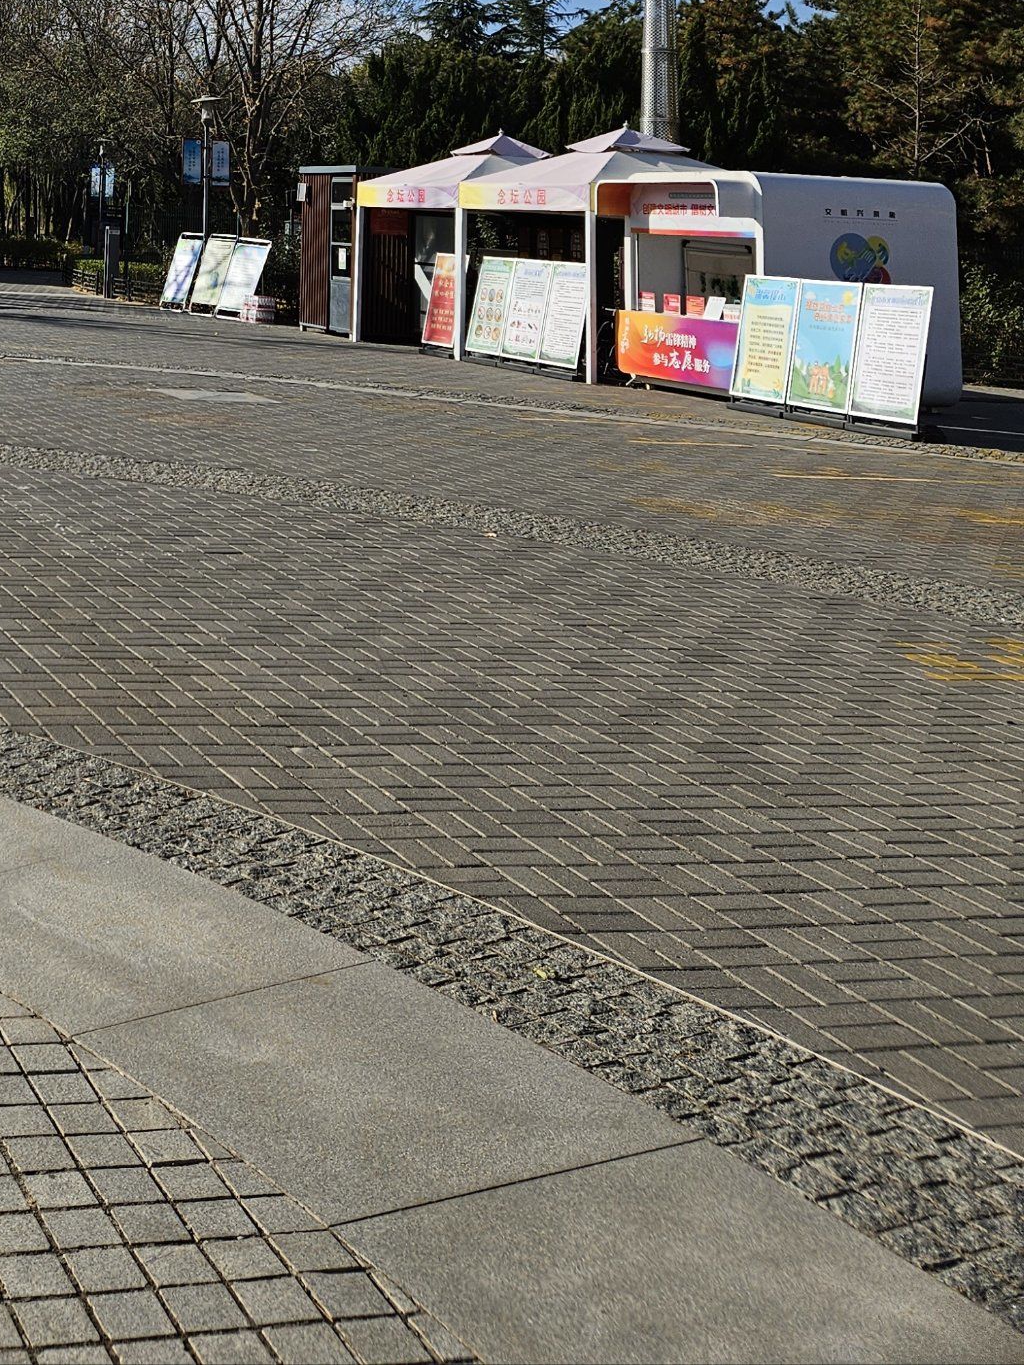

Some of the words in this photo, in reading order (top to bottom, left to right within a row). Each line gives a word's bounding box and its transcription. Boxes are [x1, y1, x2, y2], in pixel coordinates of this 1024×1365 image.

[387, 188, 426, 203] 念坛公园
[497, 188, 547, 205] 念坛公园
[690, 203, 717, 217] 倡树文
[640, 324, 697, 350] 弘扬雷锋精神
[652, 349, 711, 374] 参与志愿服务
